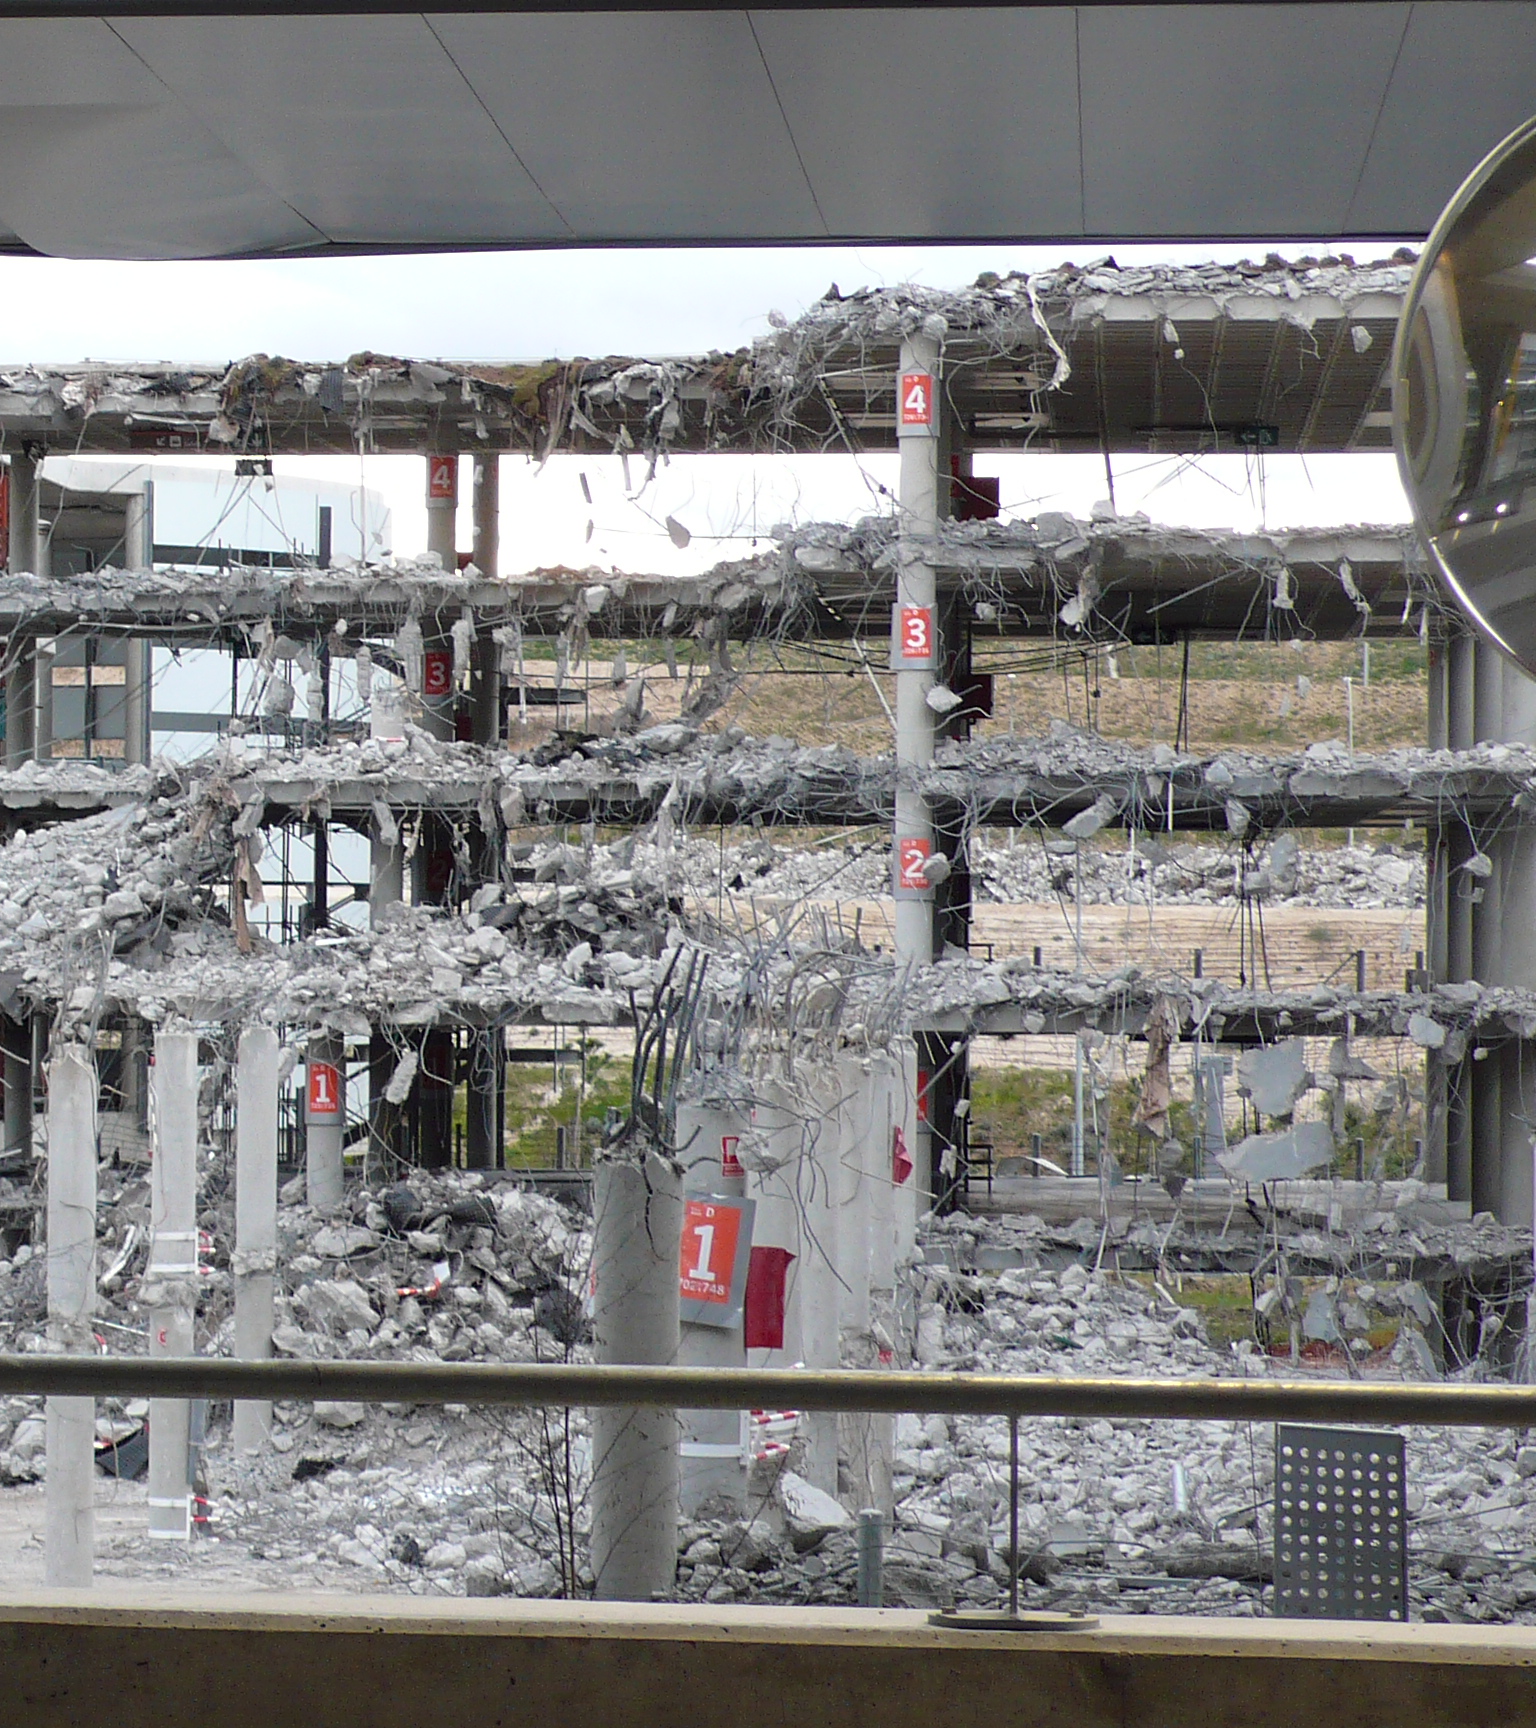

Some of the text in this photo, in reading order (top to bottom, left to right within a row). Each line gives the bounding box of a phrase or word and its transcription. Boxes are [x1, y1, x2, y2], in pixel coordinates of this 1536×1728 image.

[905, 385, 926, 414] 4
[432, 465, 450, 489] 4
[906, 618, 926, 648] 3
[429, 661, 446, 686] 3
[905, 849, 925, 878] 2
[315, 1074, 331, 1103] 1
[705, 1207, 715, 1218] D
[689, 1224, 716, 1282] 1
